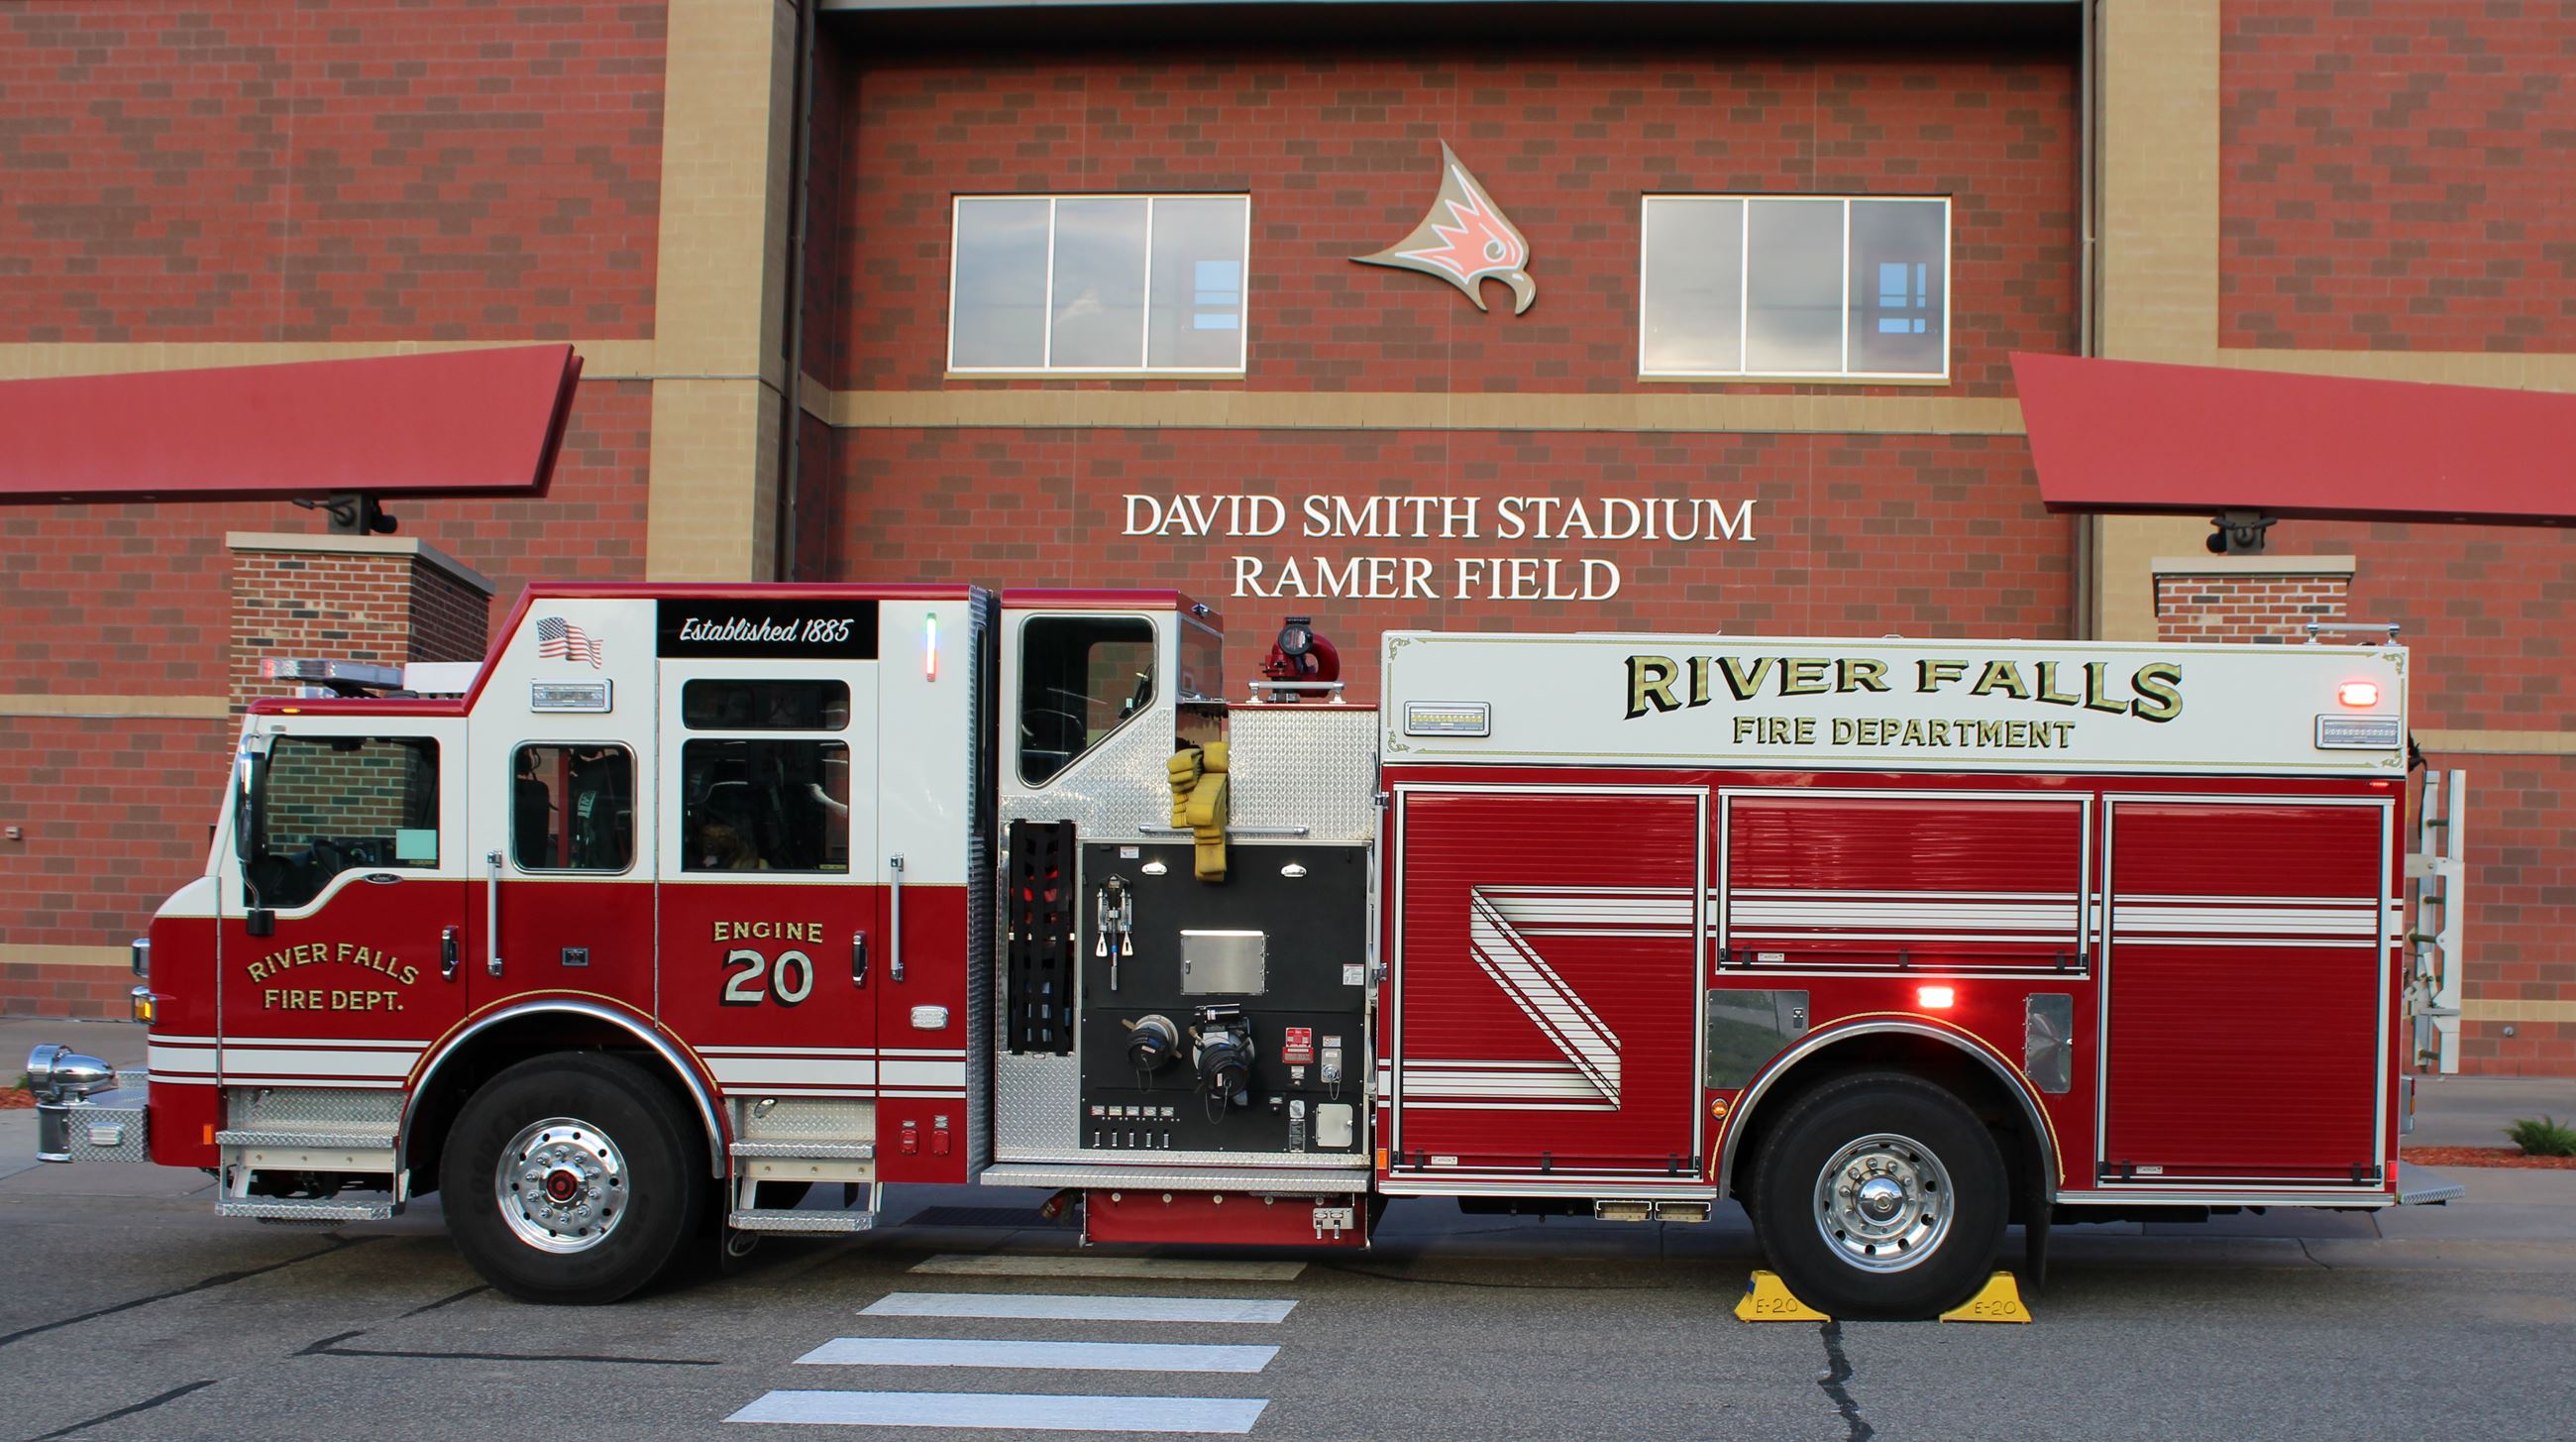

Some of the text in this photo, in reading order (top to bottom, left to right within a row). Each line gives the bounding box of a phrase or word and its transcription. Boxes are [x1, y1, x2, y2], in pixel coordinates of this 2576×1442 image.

[1121, 494, 1758, 541] DAVID SMITH STADIUM
[1231, 555, 1621, 602] RAMER FIELD
[680, 616, 855, 643] Established 1885
[1624, 655, 2184, 722] RIVER FALLS
[1733, 716, 2077, 748] FIRE DEPARTMENT
[712, 921, 823, 943] ENGINE
[246, 943, 419, 985] RIVER FALLS
[719, 948, 814, 1008] 20
[264, 989, 404, 1011] FIRE DEPT.
[1756, 1297, 1799, 1314] E-20
[1975, 1299, 2017, 1316] E-20
